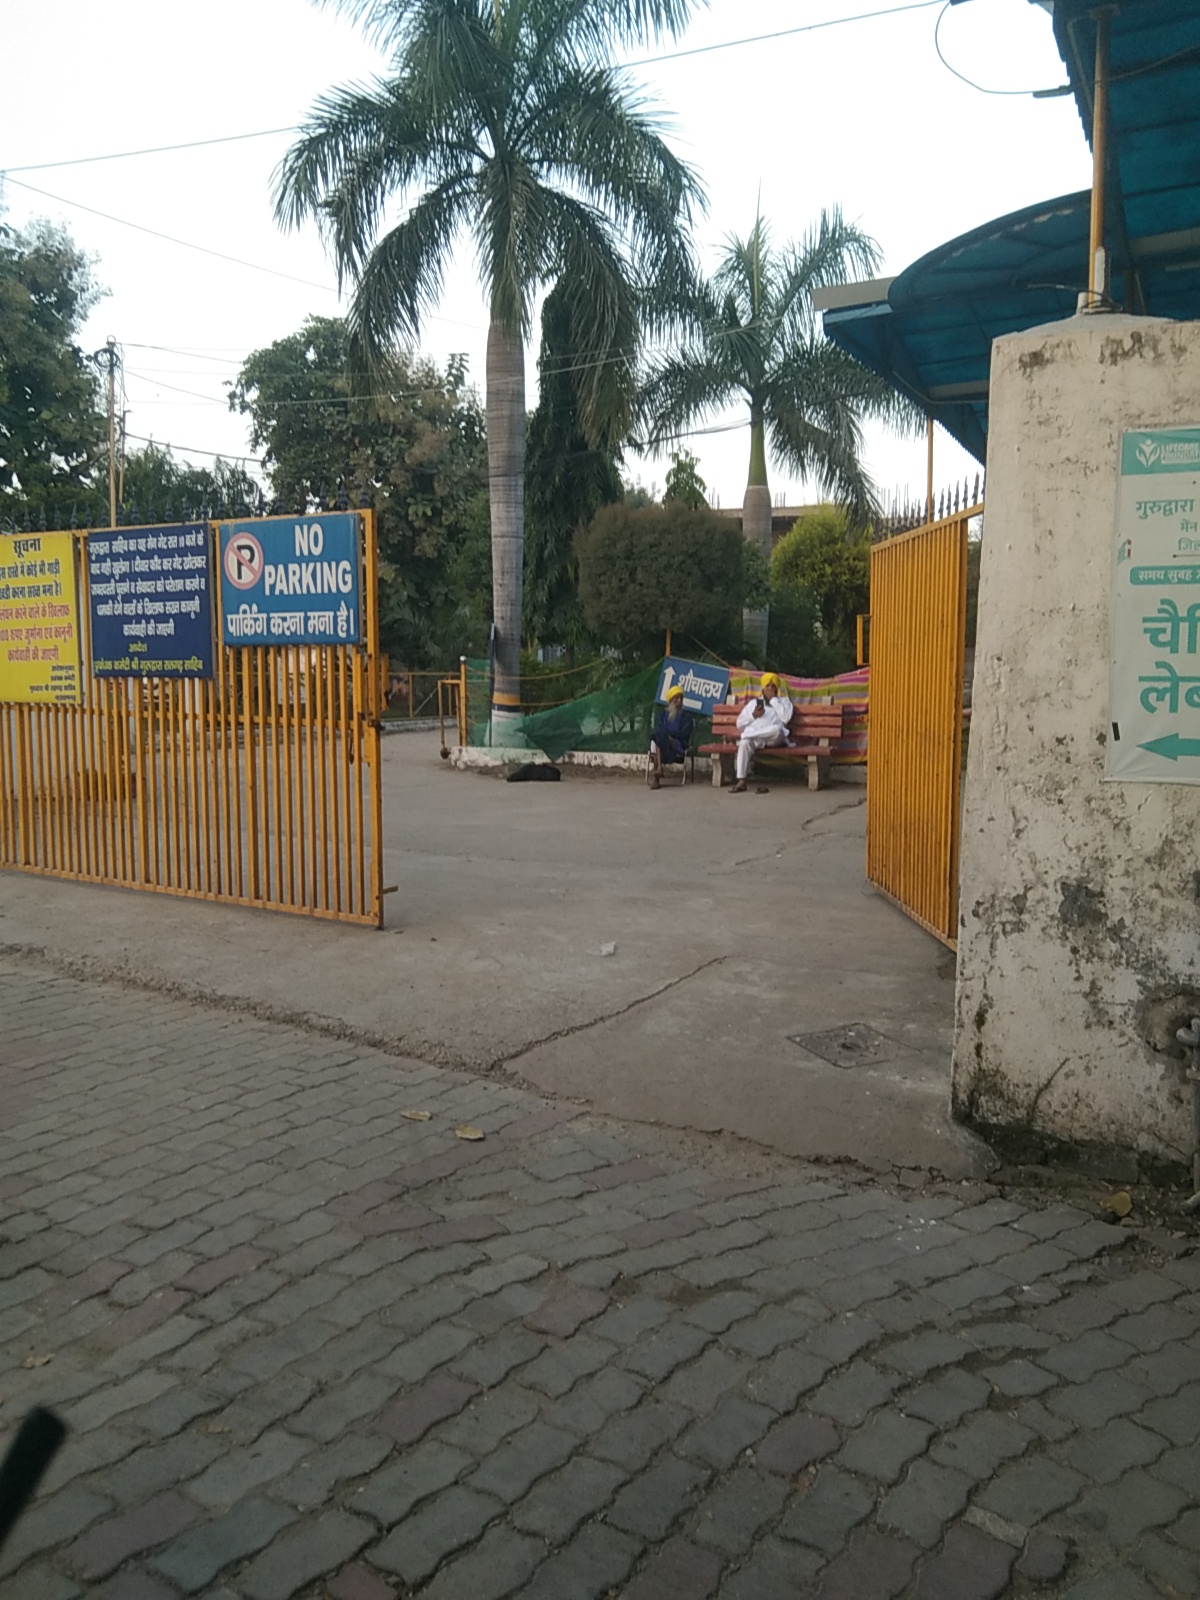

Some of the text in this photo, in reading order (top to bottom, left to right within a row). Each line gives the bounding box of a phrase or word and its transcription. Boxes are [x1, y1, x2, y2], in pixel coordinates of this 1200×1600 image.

[1135, 498, 1195, 520] गुरुद्वारा
[12, 537, 41, 559] सूचना
[128, 539, 137, 552] का
[294, 522, 324, 557] NO
[26, 560, 38, 578] कोई
[39, 559, 46, 575] भी
[264, 560, 353, 596] PARKING
[226, 603, 268, 637] पार्किंग
[269, 611, 305, 636] करना
[307, 611, 334, 636] मना
[677, 668, 724, 700] शौचालय
